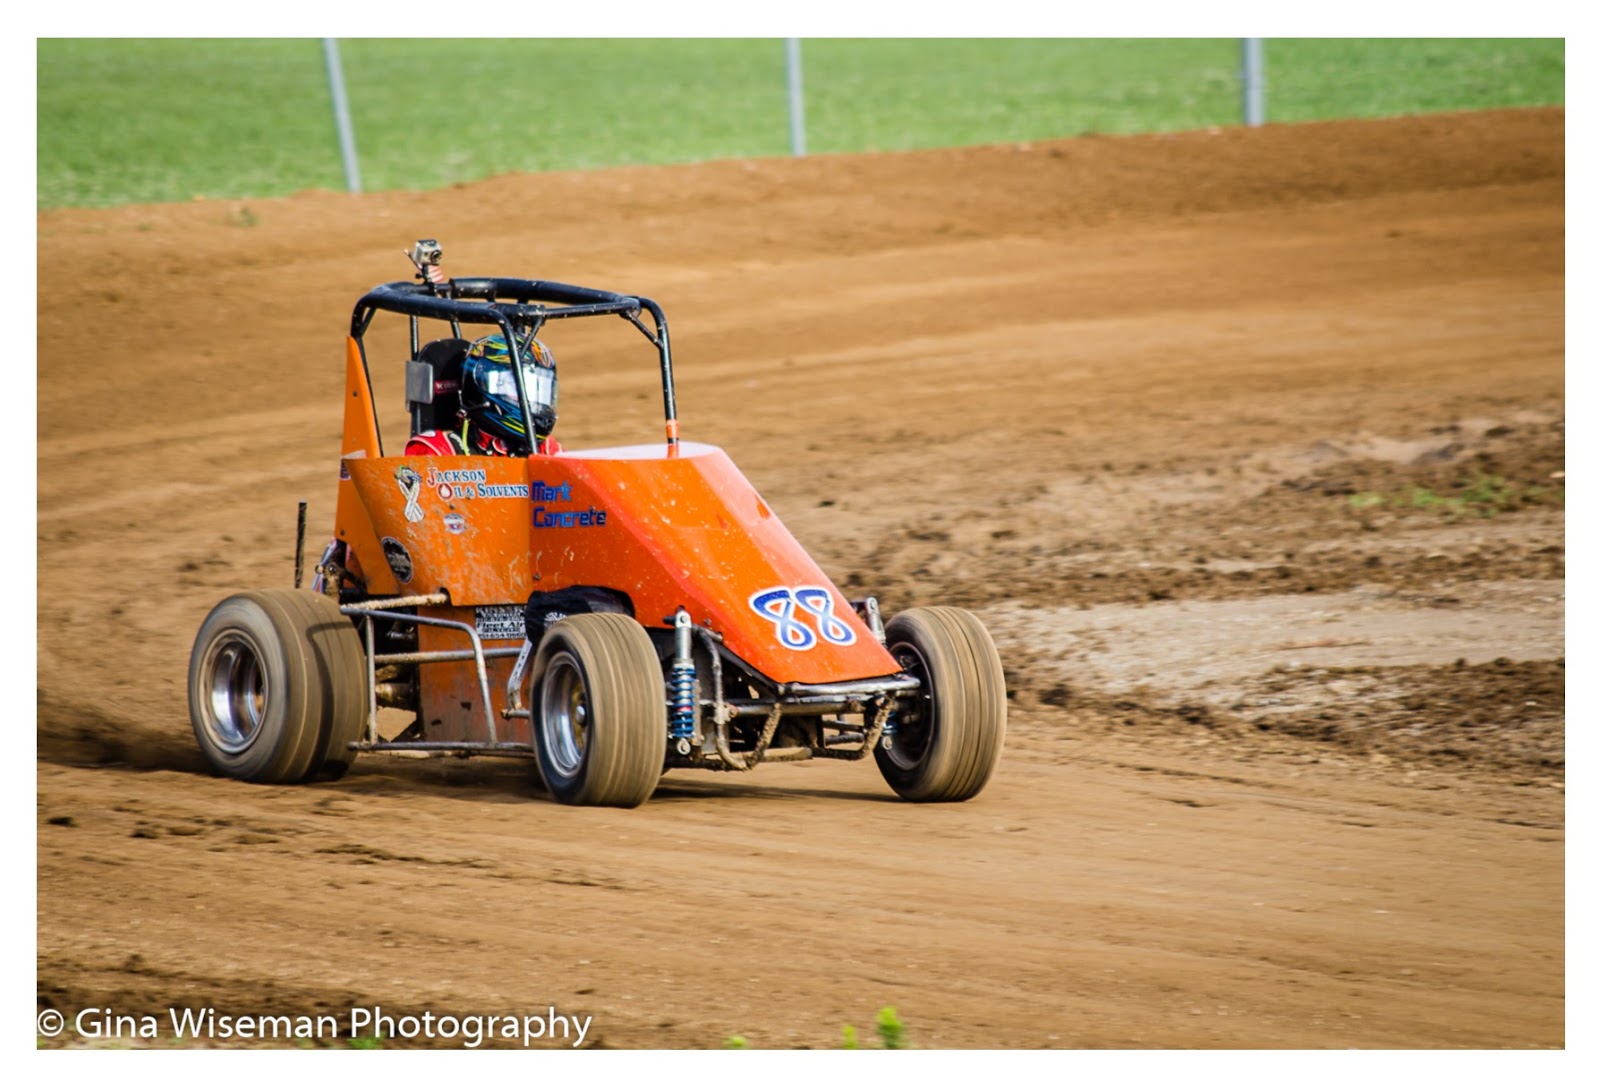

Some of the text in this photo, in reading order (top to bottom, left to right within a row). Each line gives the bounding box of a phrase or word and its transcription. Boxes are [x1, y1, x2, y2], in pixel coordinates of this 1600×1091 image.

[466, 485, 475, 498] &
[532, 480, 573, 501] Mark
[533, 505, 607, 528] Concrete
[748, 585, 857, 651] 88
